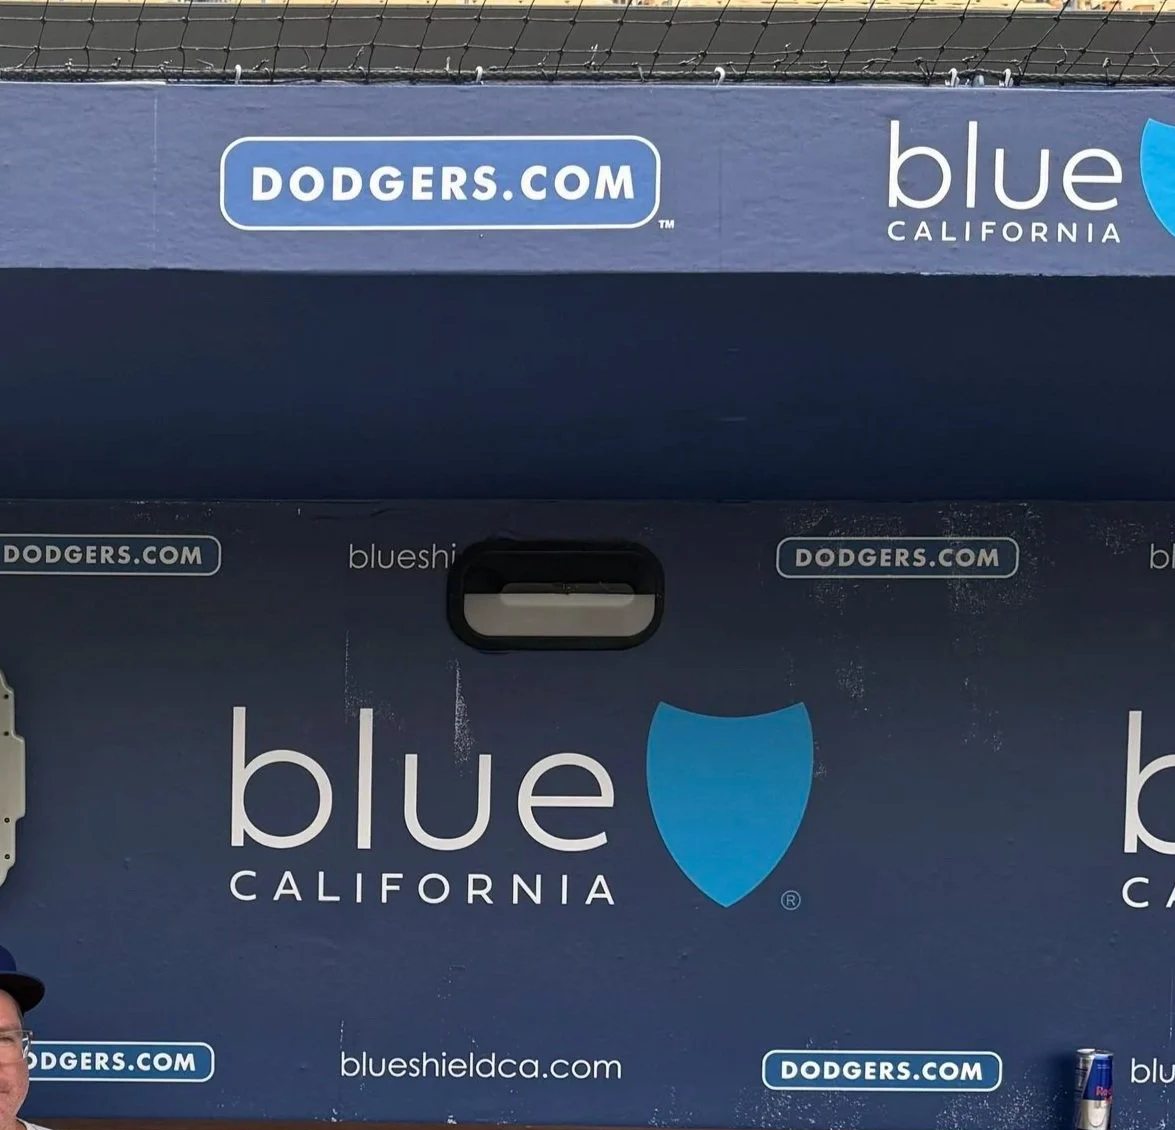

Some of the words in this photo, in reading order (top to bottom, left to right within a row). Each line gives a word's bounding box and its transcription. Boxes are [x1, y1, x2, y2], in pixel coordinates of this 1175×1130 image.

[889, 119, 1123, 211] blue
[252, 164, 634, 202] DODGERS.COM
[887, 220, 1121, 243] CALIFORNIA
[3, 544, 202, 565] DODGERS.COM
[795, 547, 999, 567] DODGERS.COM
[230, 705, 615, 852] blue
[229, 870, 615, 905] CALIFORNIA
[341, 1051, 622, 1079] blueshieldca.com
[780, 1061, 983, 1082] DODGERS.COM
